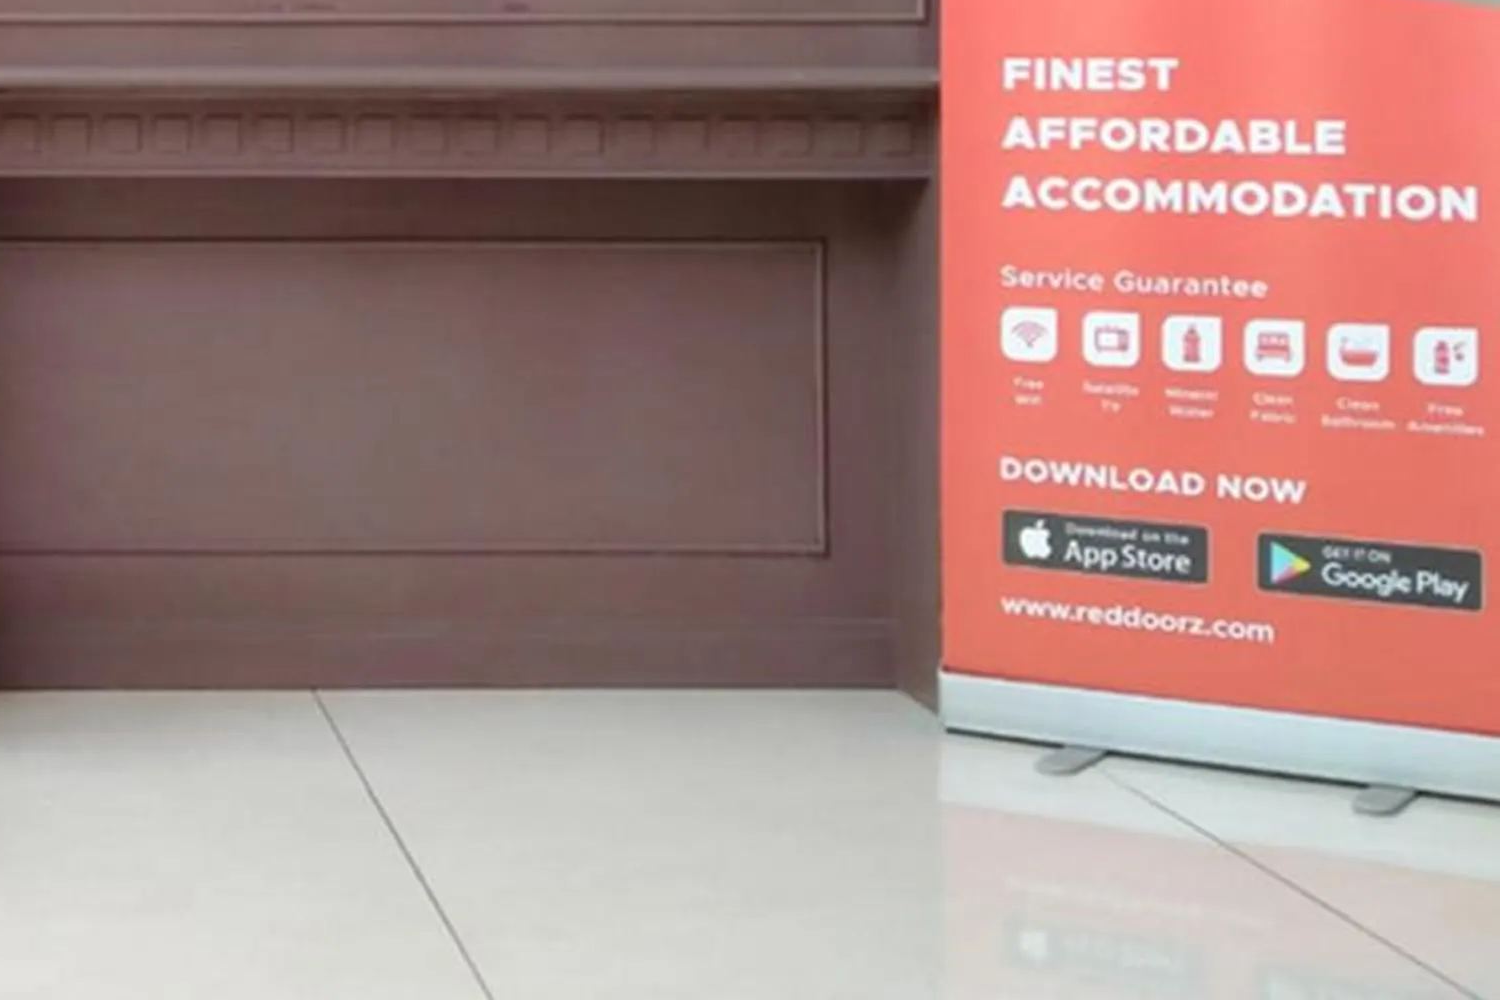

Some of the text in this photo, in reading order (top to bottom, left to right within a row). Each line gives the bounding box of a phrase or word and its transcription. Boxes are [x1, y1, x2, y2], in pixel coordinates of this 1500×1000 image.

[1002, 57, 1179, 92] FINEST
[1001, 117, 1348, 156] AFFORDABLE
[1001, 176, 1479, 222] ACCOMMODATION
[1000, 264, 1269, 299] Service Guarantee
[1000, 456, 1307, 504] DOWNLOAD NOW
[1064, 522, 1190, 546] Download on the
[1063, 540, 1193, 574] App Store
[1321, 544, 1350, 560] GET
[1367, 549, 1393, 564] ON
[1321, 562, 1470, 604] Google Play
[1001, 596, 1275, 644] www.reddoorz.com
